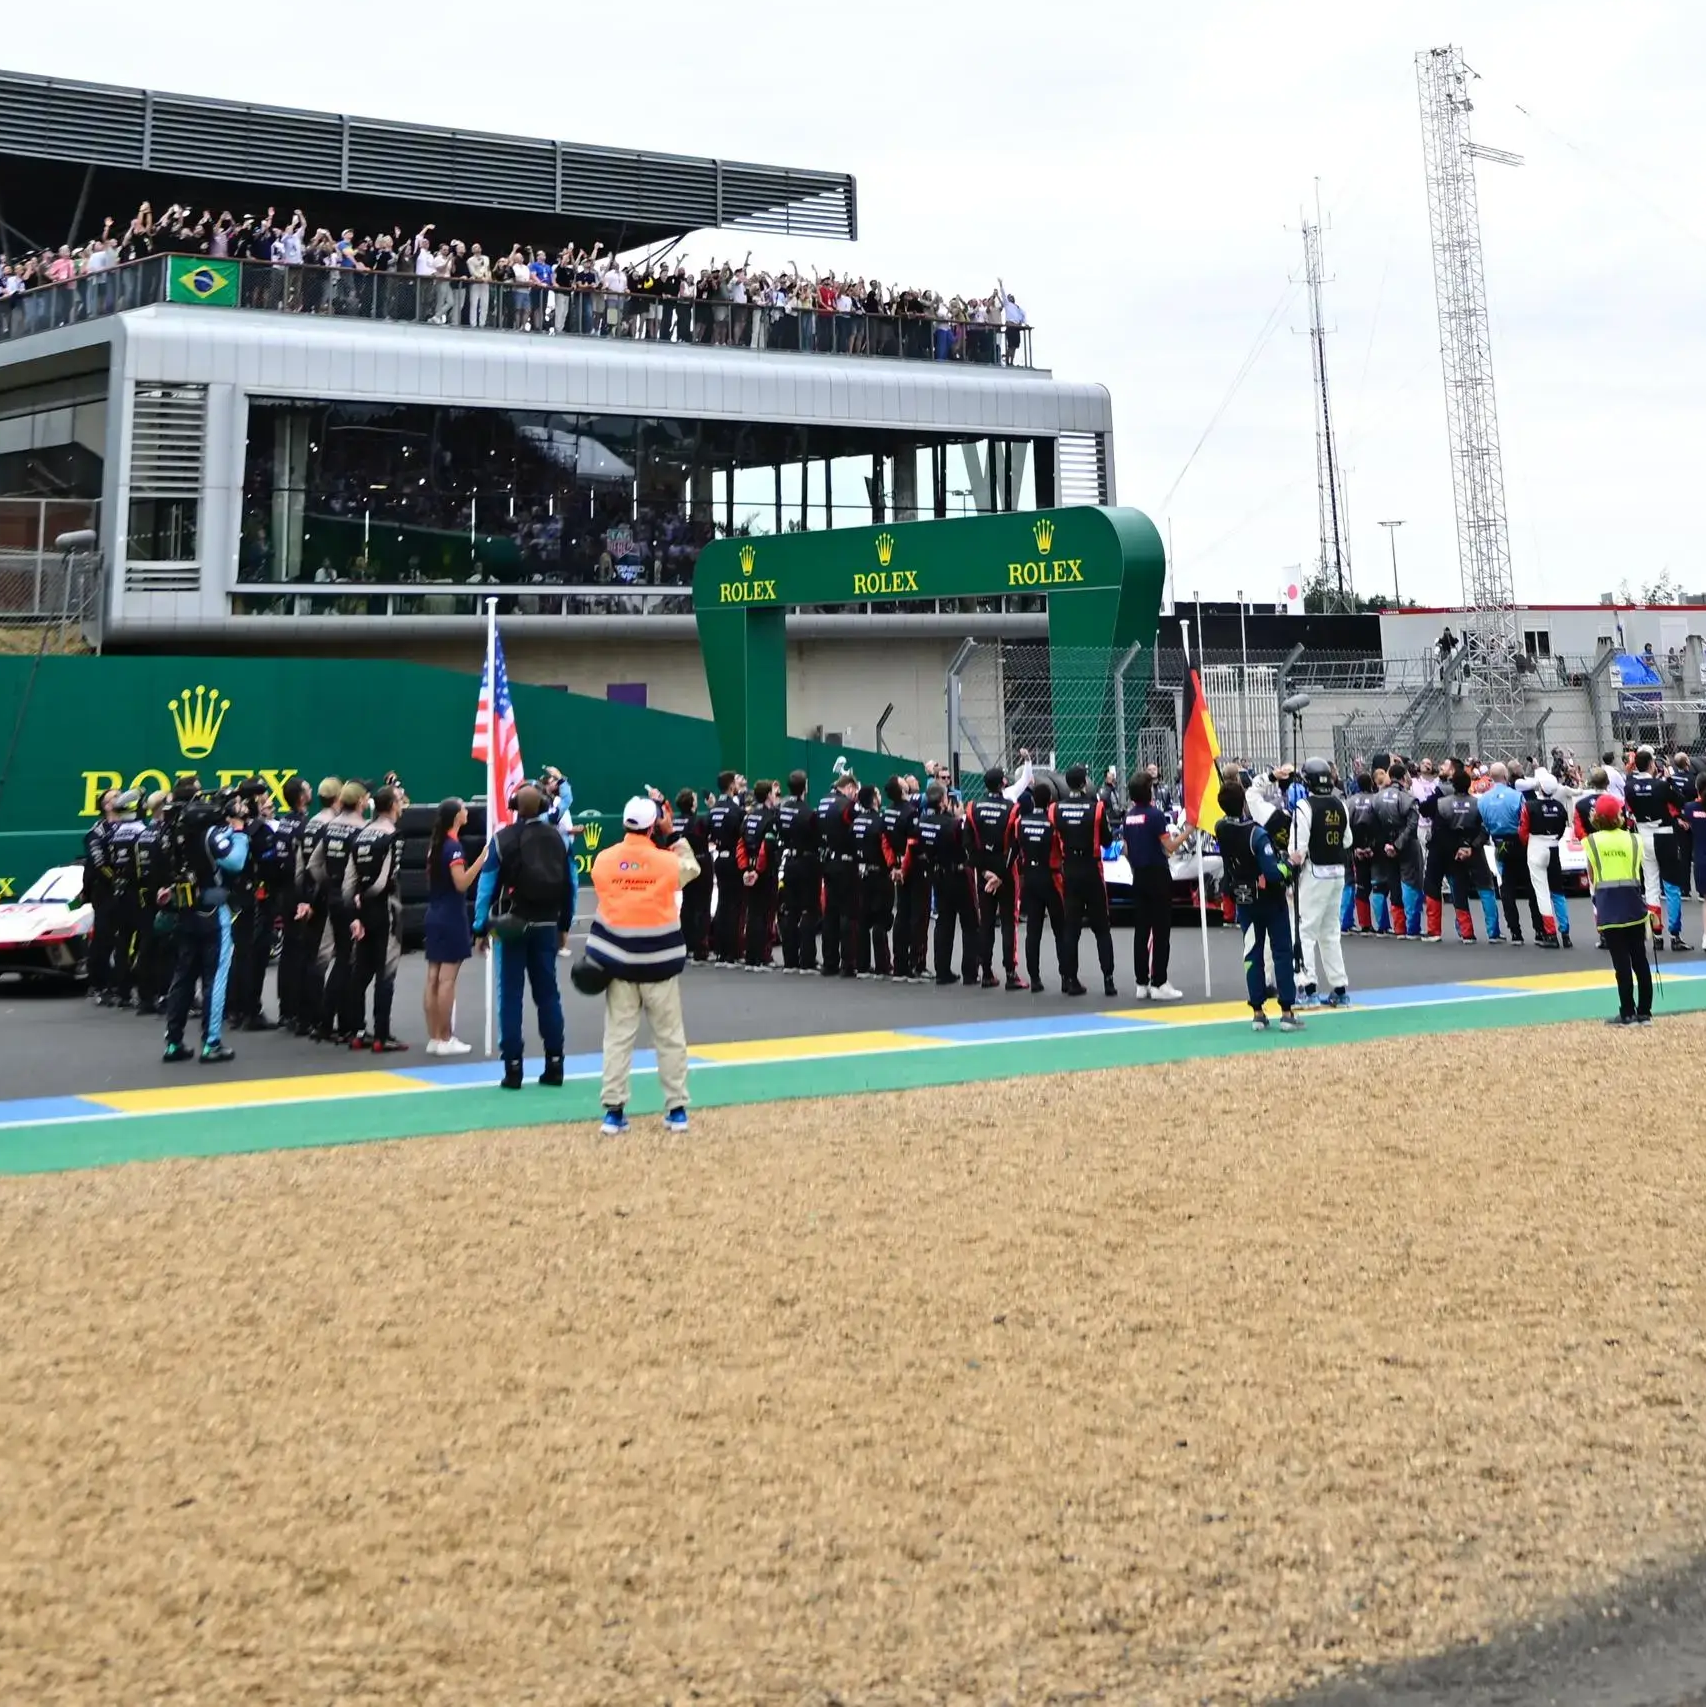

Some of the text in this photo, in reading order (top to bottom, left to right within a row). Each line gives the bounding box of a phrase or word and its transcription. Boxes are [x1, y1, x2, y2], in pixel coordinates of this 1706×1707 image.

[853, 570, 919, 595] ROLEX
[1008, 559, 1084, 586] ROLEX
[719, 580, 777, 603] ROLEX
